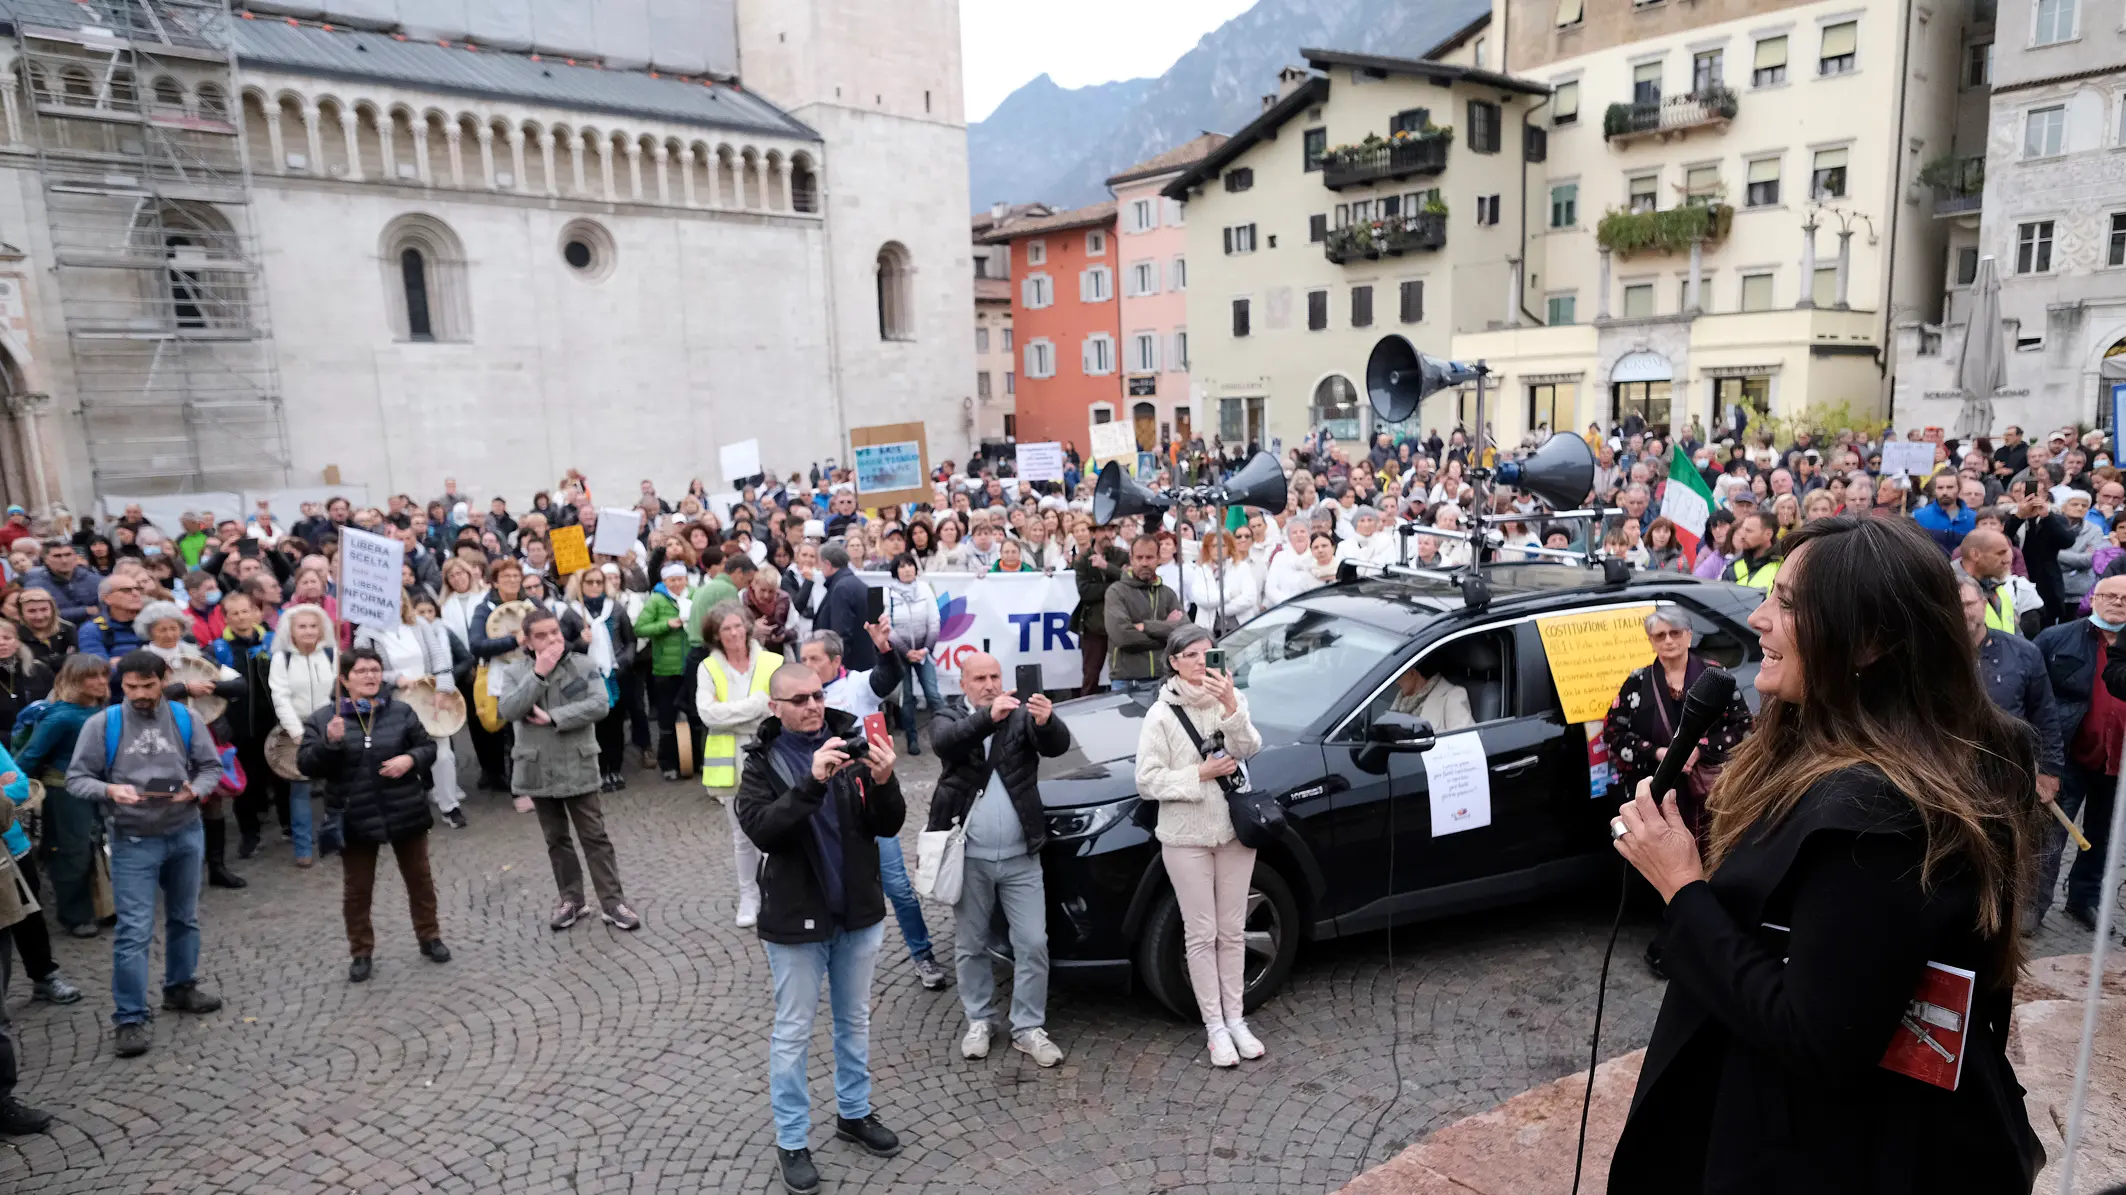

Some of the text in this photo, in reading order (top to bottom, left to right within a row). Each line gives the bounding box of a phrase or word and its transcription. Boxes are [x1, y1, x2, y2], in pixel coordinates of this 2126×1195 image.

[350, 540, 390, 557] LIBERA
[349, 551, 390, 569] SCELTA
[352, 578, 385, 593] LIBERA
[349, 603, 385, 619] ZIONE
[1008, 611, 1082, 653] TR
[1544, 620, 1609, 638] COSTITUZIONE
